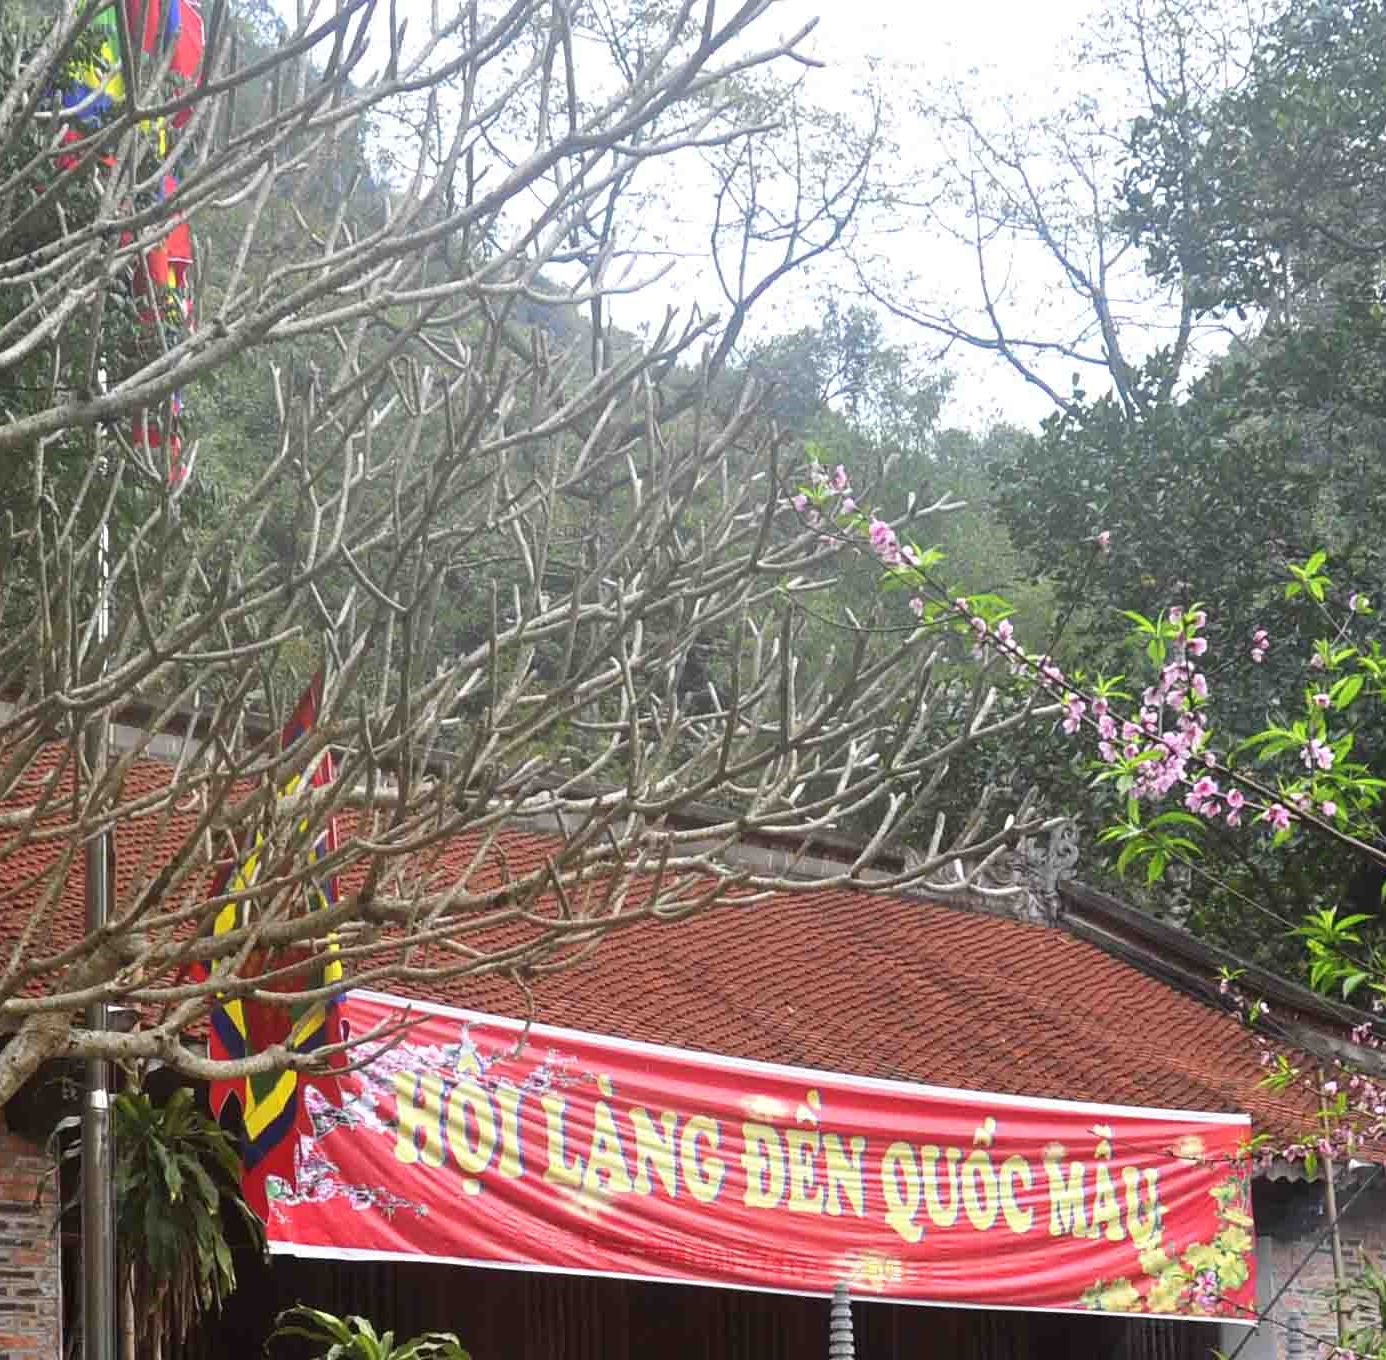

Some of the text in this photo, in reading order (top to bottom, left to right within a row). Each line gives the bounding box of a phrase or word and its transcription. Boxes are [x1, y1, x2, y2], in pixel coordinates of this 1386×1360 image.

[393, 1050, 525, 1196] HỘI
[541, 1072, 728, 1203] LÀNG
[742, 1089, 866, 1217] ĐỀN
[881, 1116, 1036, 1243] QUỐC
